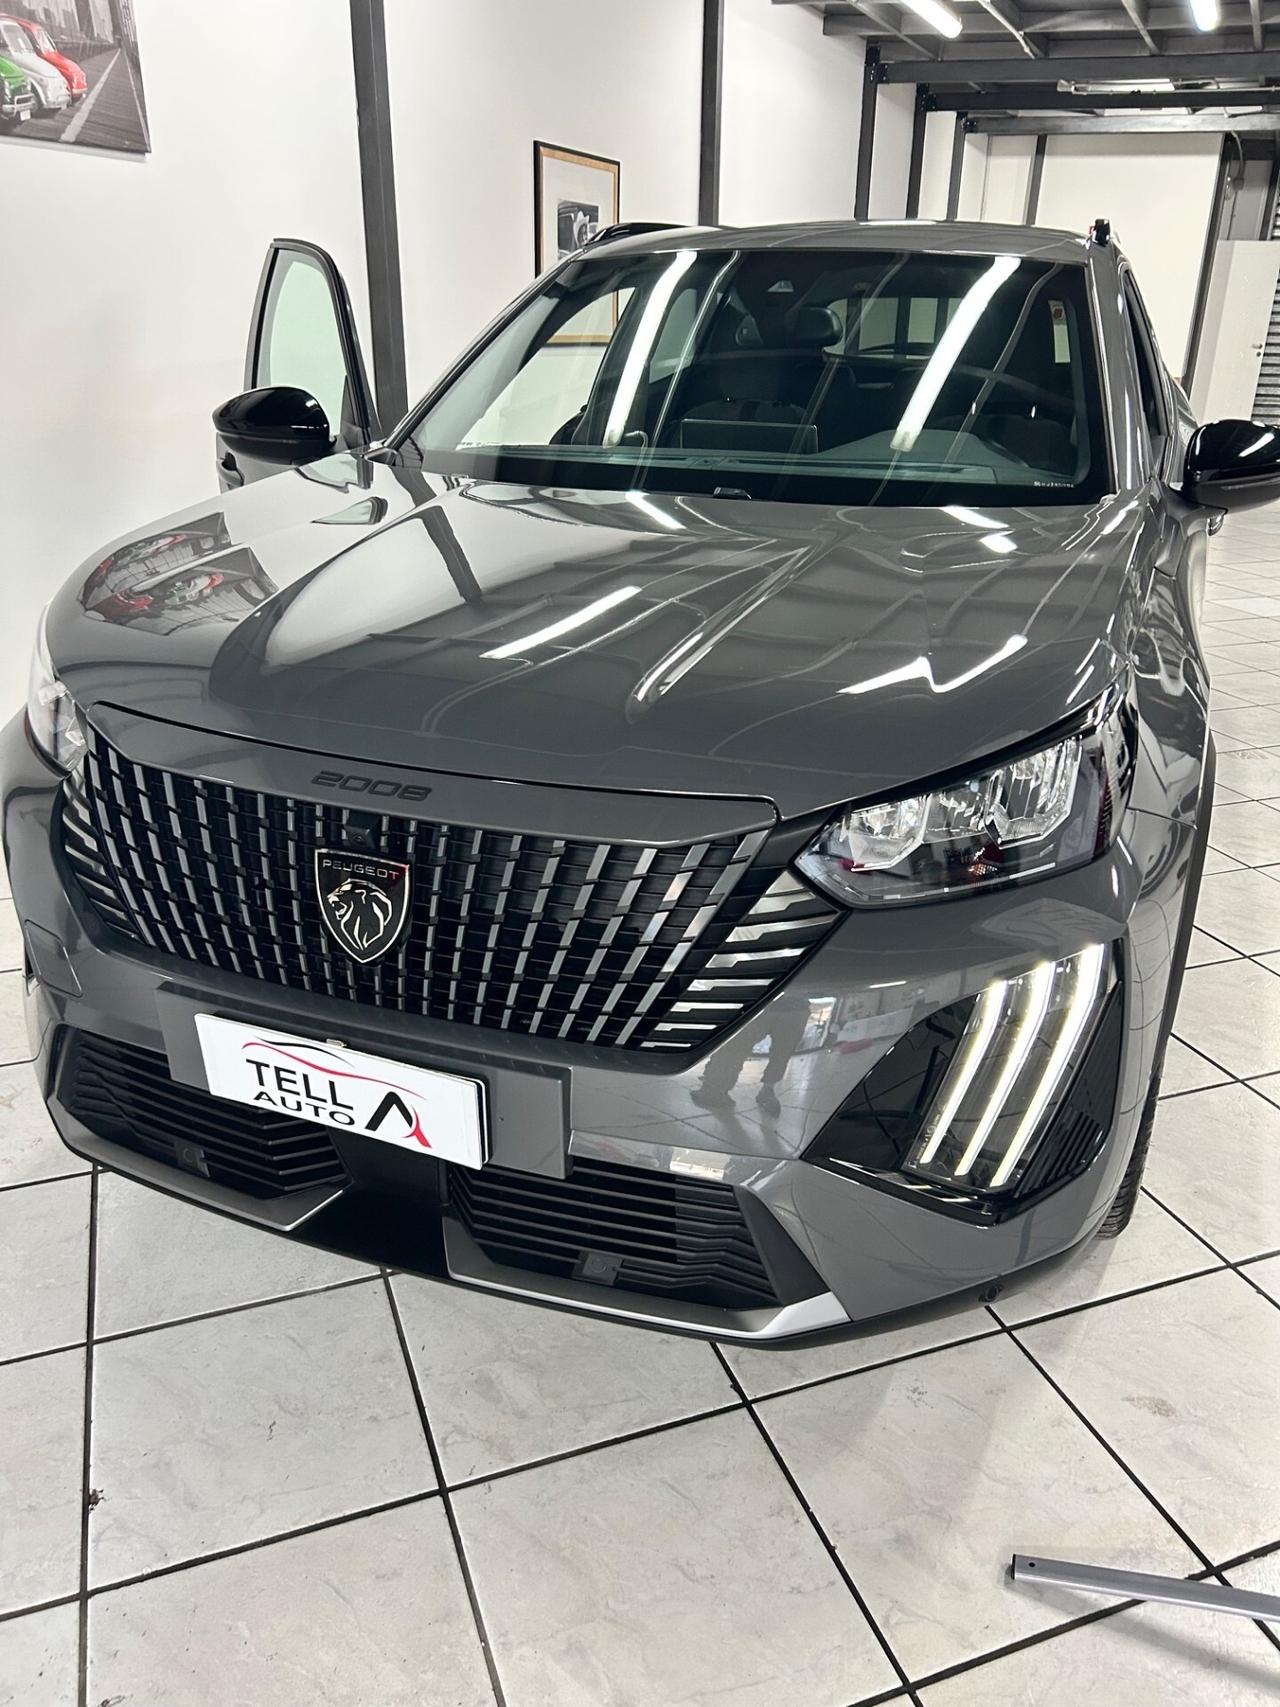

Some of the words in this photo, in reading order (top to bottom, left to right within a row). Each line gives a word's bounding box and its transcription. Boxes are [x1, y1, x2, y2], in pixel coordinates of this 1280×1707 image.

[311, 770, 432, 802] 2008
[322, 859, 400, 880] PEUGEOT
[246, 1058, 354, 1111] TELL
[253, 1091, 356, 1126] AUTO
